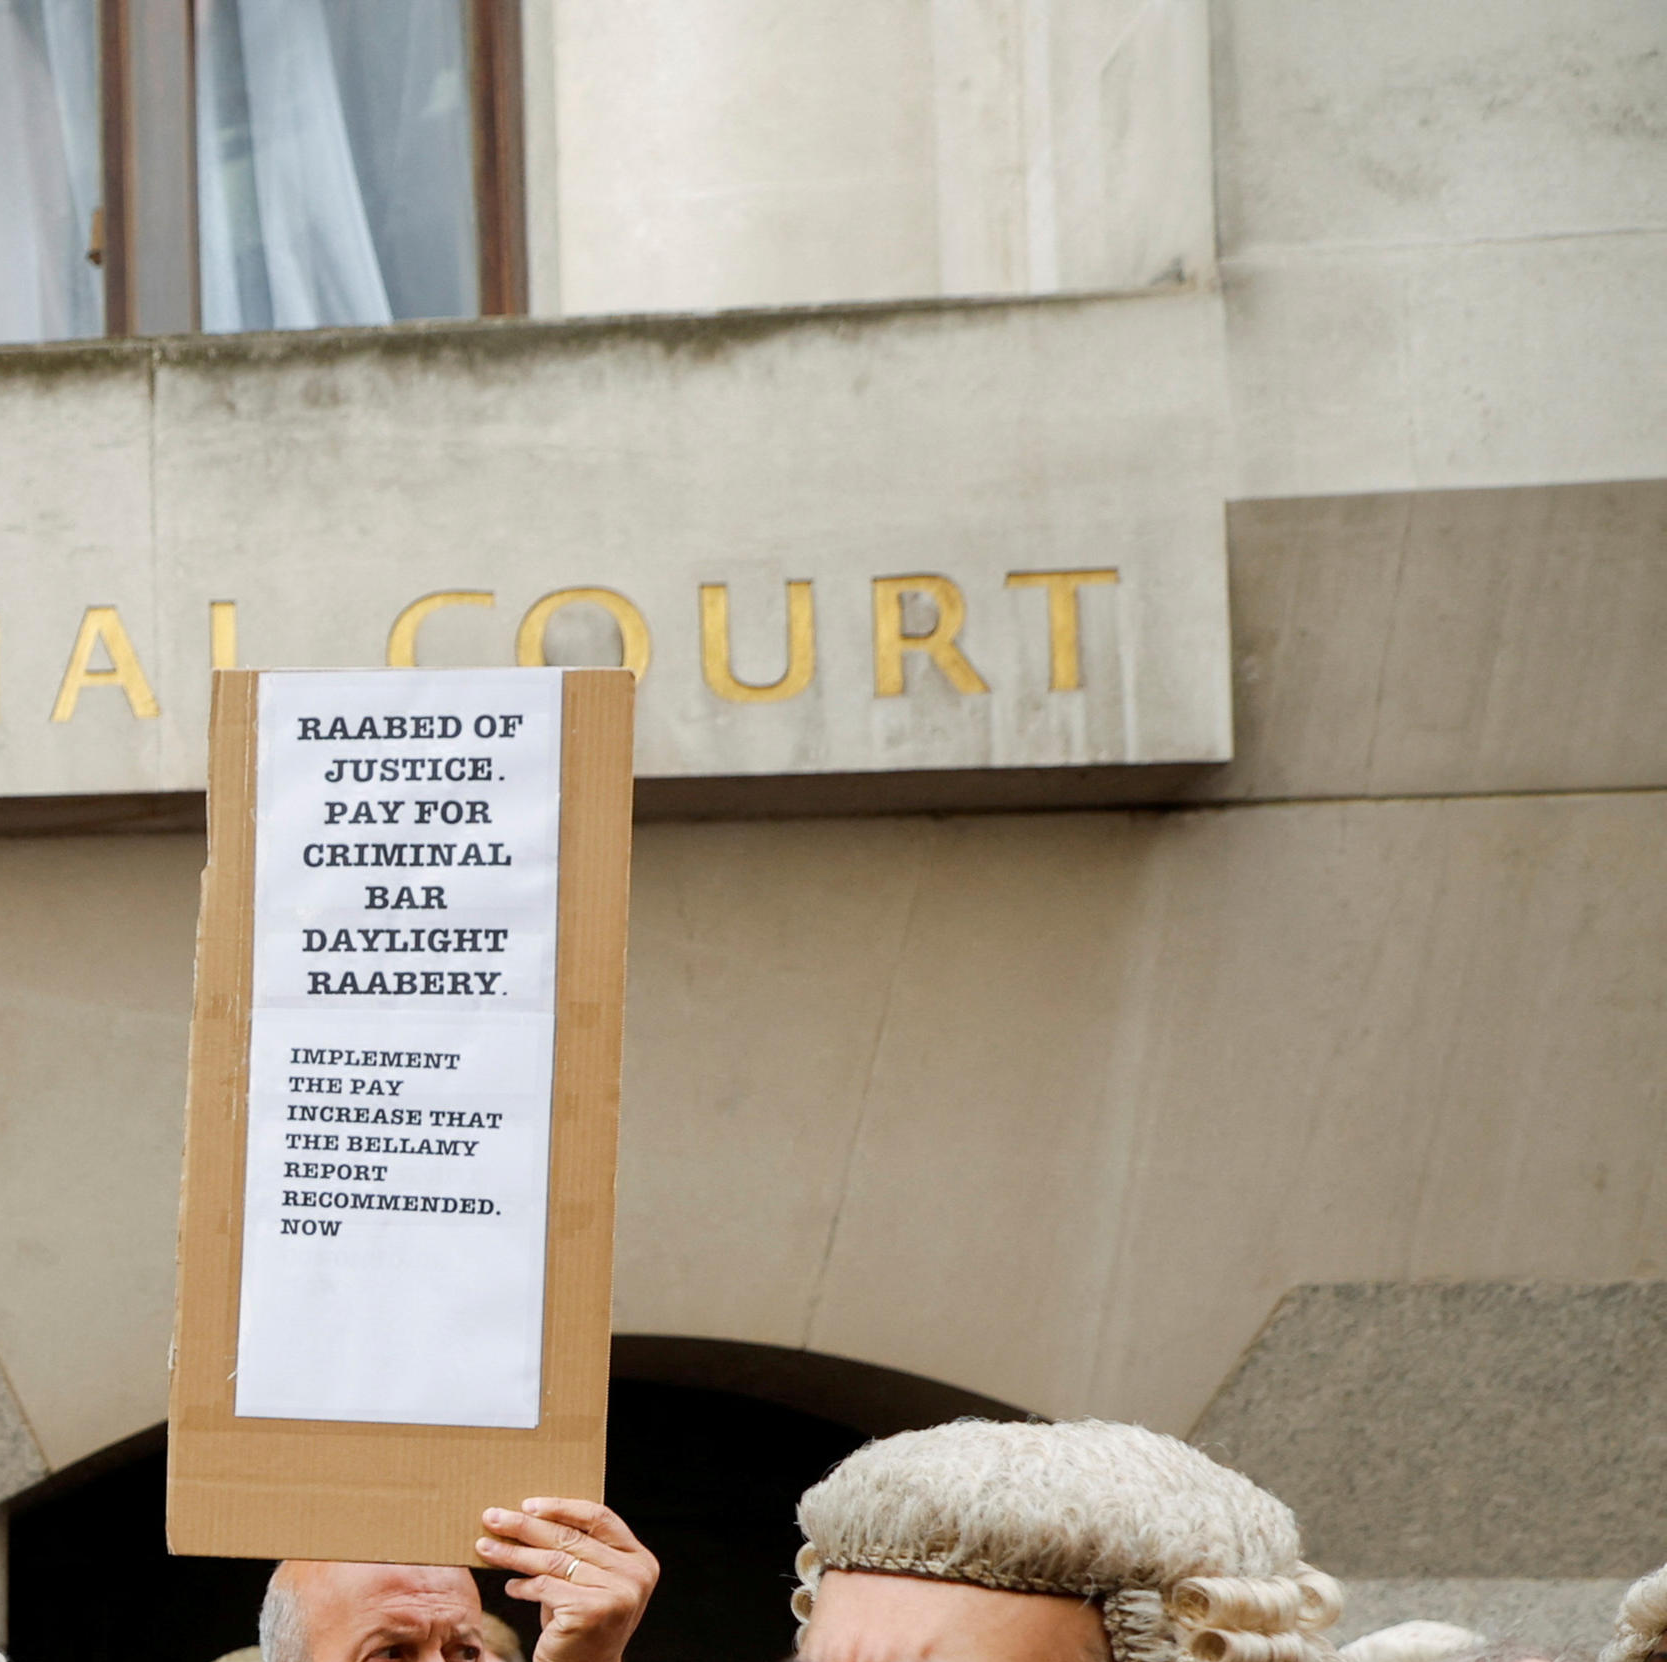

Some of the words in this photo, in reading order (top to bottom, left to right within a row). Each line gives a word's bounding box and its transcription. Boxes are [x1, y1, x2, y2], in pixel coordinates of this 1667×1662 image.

[297, 715, 463, 740] RAABED
[474, 714, 524, 738] OF
[324, 757, 505, 783] JUSTICE.
[324, 801, 405, 825] PAY
[414, 800, 492, 824] FOR
[302, 842, 511, 869] CRIMINAL
[365, 886, 447, 910] BAR
[302, 928, 508, 955] DAYLIGHT
[307, 971, 508, 997] RAABERY.
[290, 1048, 460, 1070] IMPLEMENT
[289, 1077, 342, 1096] THE
[349, 1079, 404, 1097] PAY
[287, 1106, 423, 1127] INCREASE
[430, 1111, 503, 1129] THAT
[286, 1135, 338, 1153] THE
[346, 1136, 478, 1157] BELLAMY
[284, 1162, 387, 1182] REPORT
[282, 1191, 501, 1217] RECOMMENDED.
[281, 1219, 342, 1238] NOW
